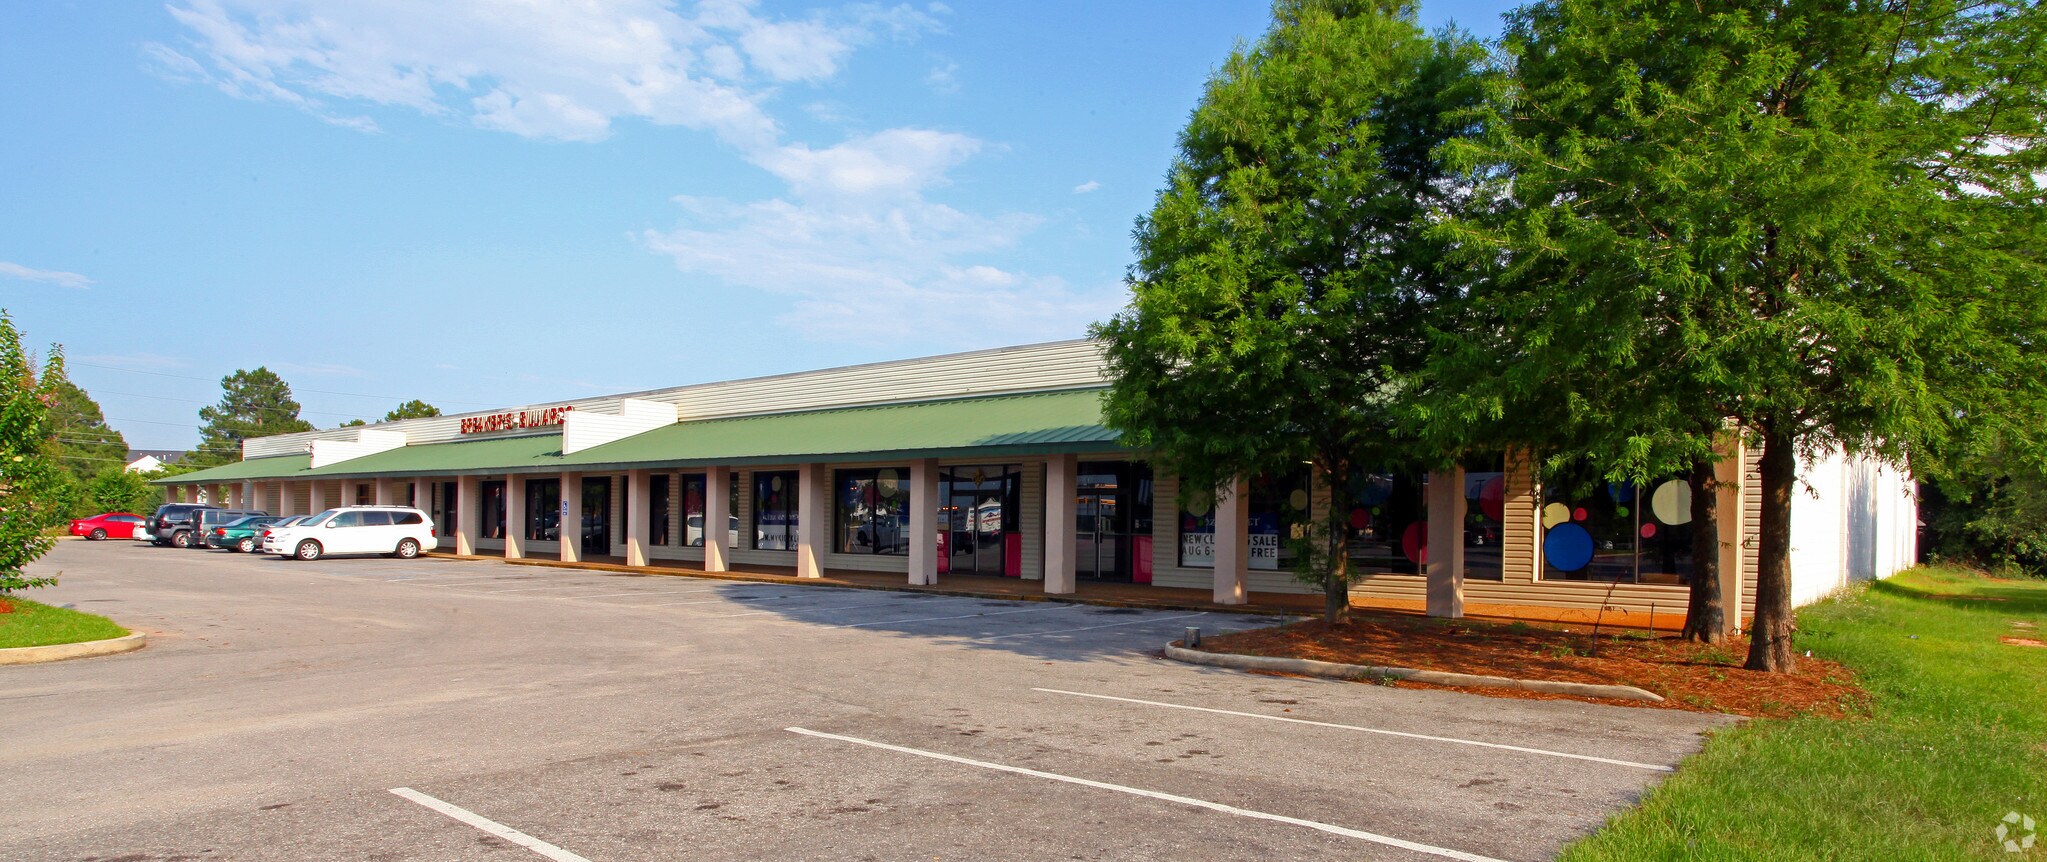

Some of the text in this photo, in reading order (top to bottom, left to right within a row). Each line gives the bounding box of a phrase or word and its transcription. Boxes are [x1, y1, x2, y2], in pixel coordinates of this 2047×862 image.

[1183, 534, 1201, 545] NEW
[1252, 535, 1277, 546] SALE
[1183, 545, 1202, 556] AUG
[1251, 547, 1275, 558] FREE
